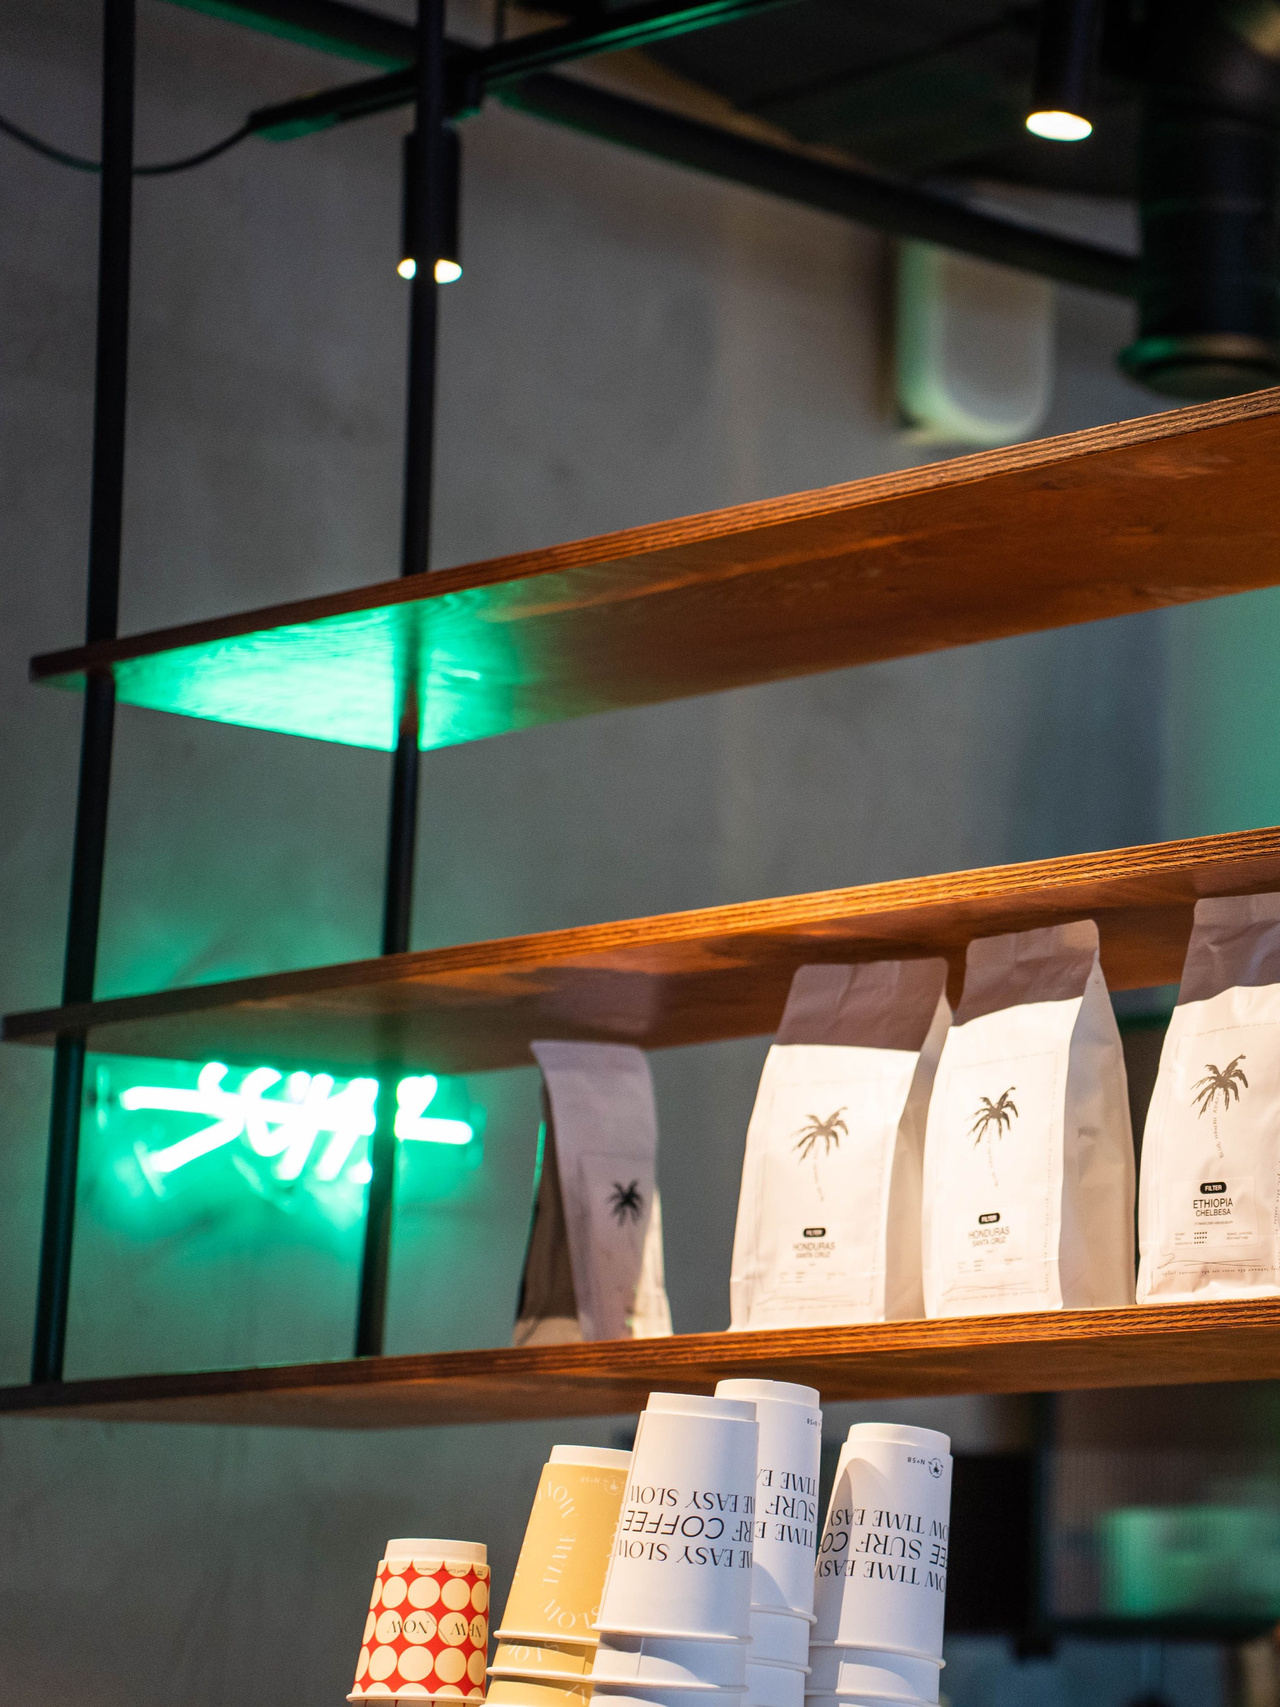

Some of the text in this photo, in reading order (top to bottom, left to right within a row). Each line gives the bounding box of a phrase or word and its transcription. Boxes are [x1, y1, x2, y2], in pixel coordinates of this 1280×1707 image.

[1204, 1184, 1223, 1192] FILTER
[1193, 1198, 1233, 1209] ETHIOPIA
[1196, 1208, 1231, 1217] CHELBESA
[968, 1226, 1010, 1239] HONDURAS
[792, 1242, 835, 1251] HONDURAS
[780, 1472, 816, 1496] TIME
[685, 1491, 738, 1512] EASY
[765, 1495, 816, 1523] SURF
[623, 1510, 724, 1540] COFFEE
[872, 1509, 925, 1535] TIME
[775, 1521, 814, 1548] TIME
[676, 1545, 733, 1568] EASY
[855, 1533, 923, 1560] SURF
[817, 1559, 856, 1578] EASY
[863, 1560, 920, 1586] TIME
[387, 1620, 483, 1638] NEW NOW
